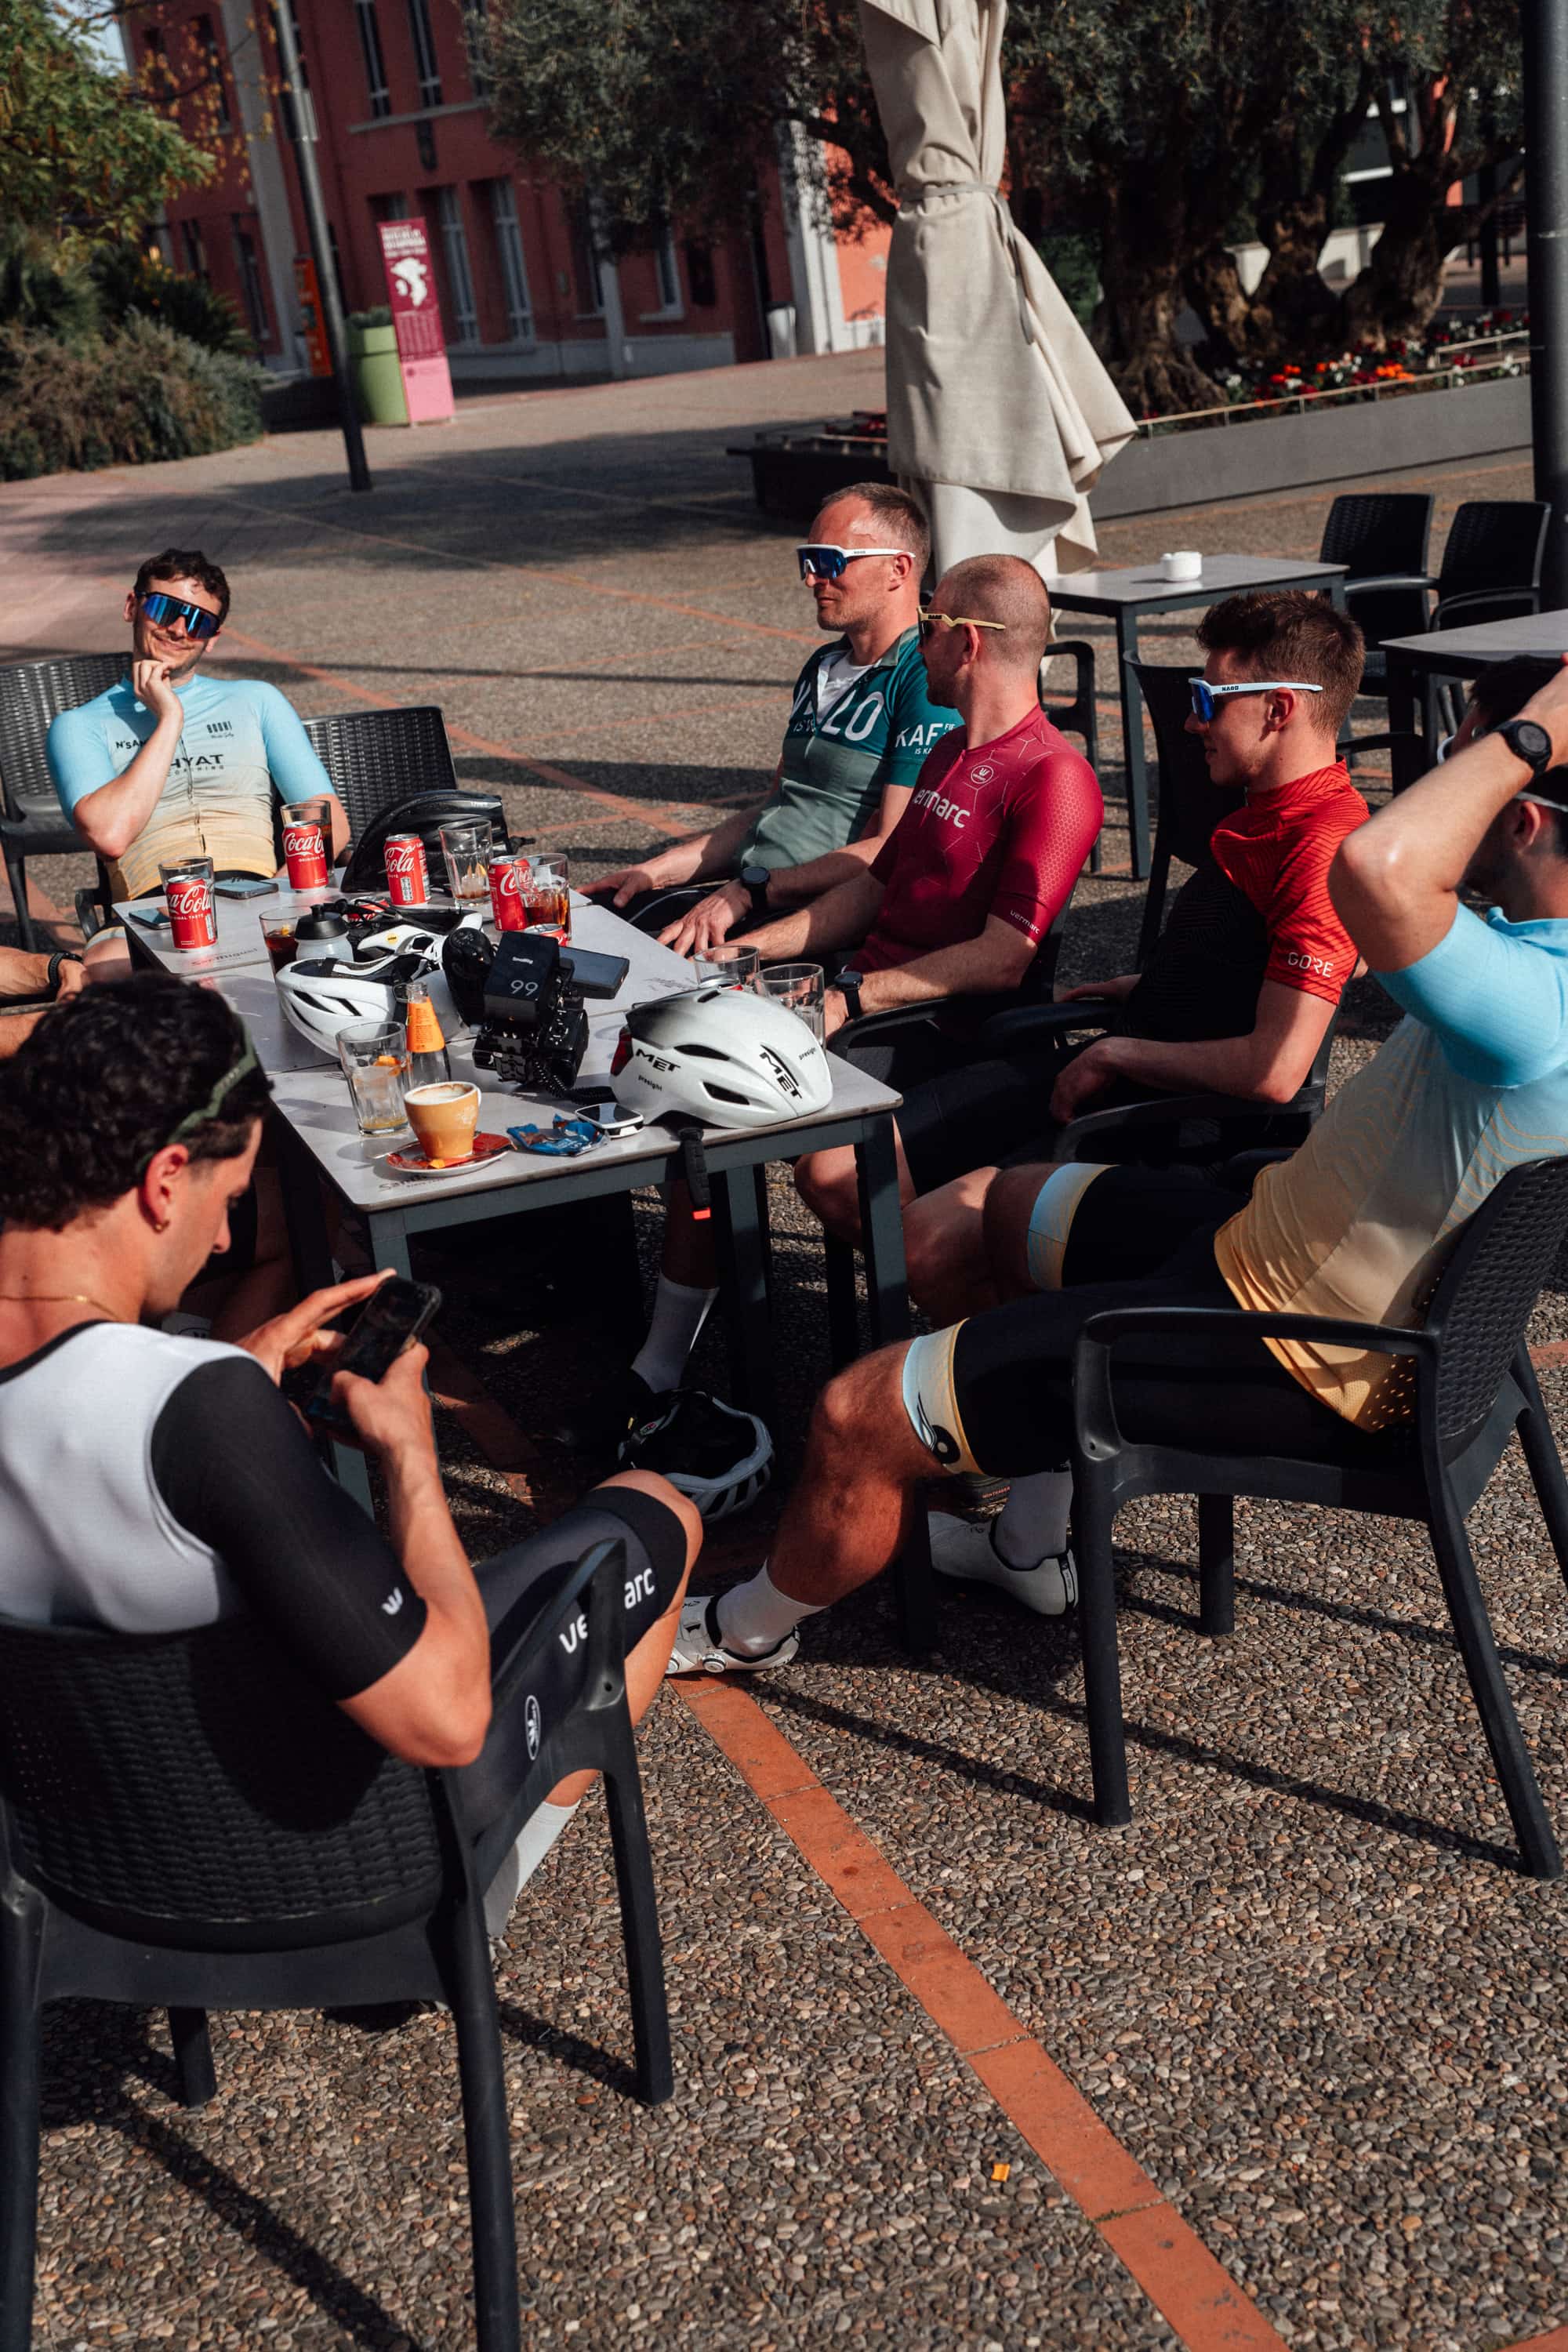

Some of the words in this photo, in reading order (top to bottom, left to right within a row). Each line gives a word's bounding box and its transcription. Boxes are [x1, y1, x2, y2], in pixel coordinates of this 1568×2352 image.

[913, 789, 971, 829] ermarc
[1288, 952, 1334, 978] GORE
[510, 979, 539, 996] 99
[636, 1048, 681, 1073] MET
[759, 1051, 803, 1099] MET
